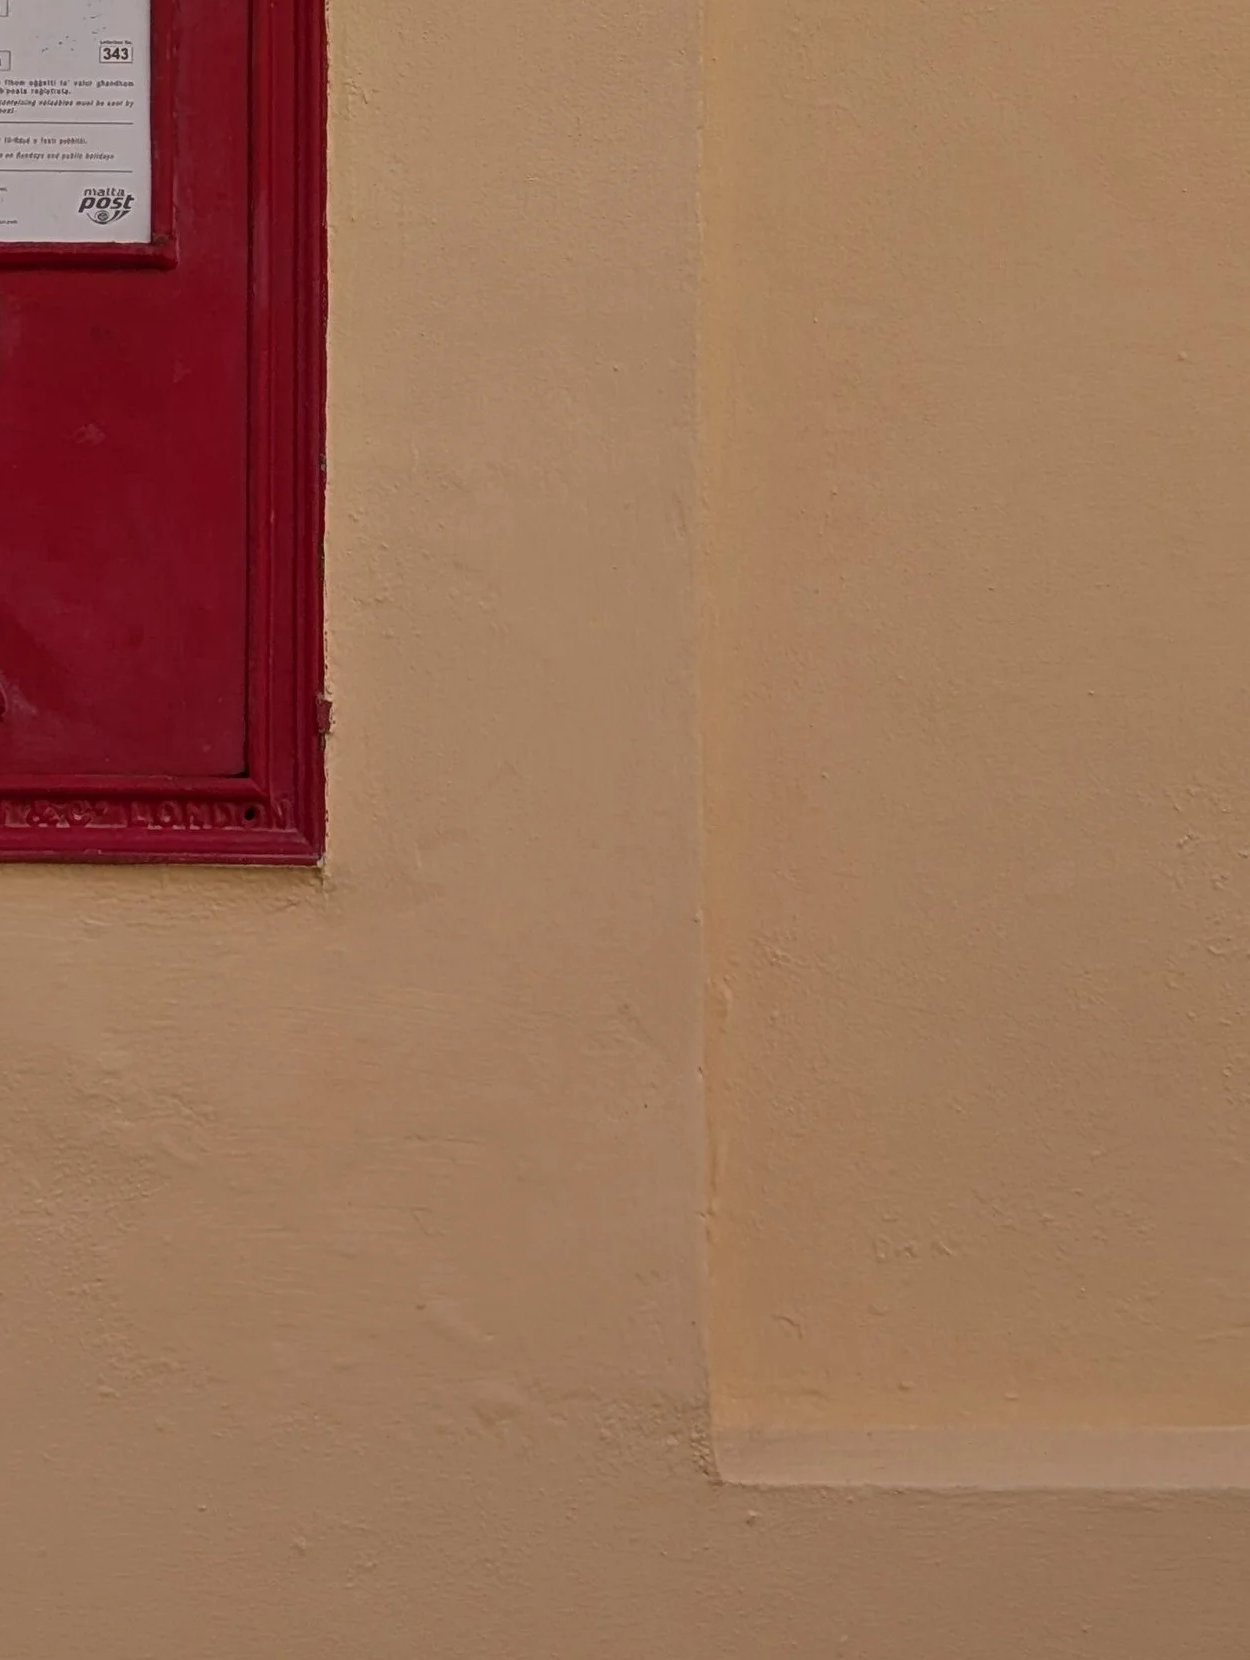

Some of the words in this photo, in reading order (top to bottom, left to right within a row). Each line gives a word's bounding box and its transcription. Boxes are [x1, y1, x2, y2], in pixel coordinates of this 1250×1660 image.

[102, 47, 129, 61] 343
[83, 187, 125, 197] malta
[77, 193, 136, 213] post
